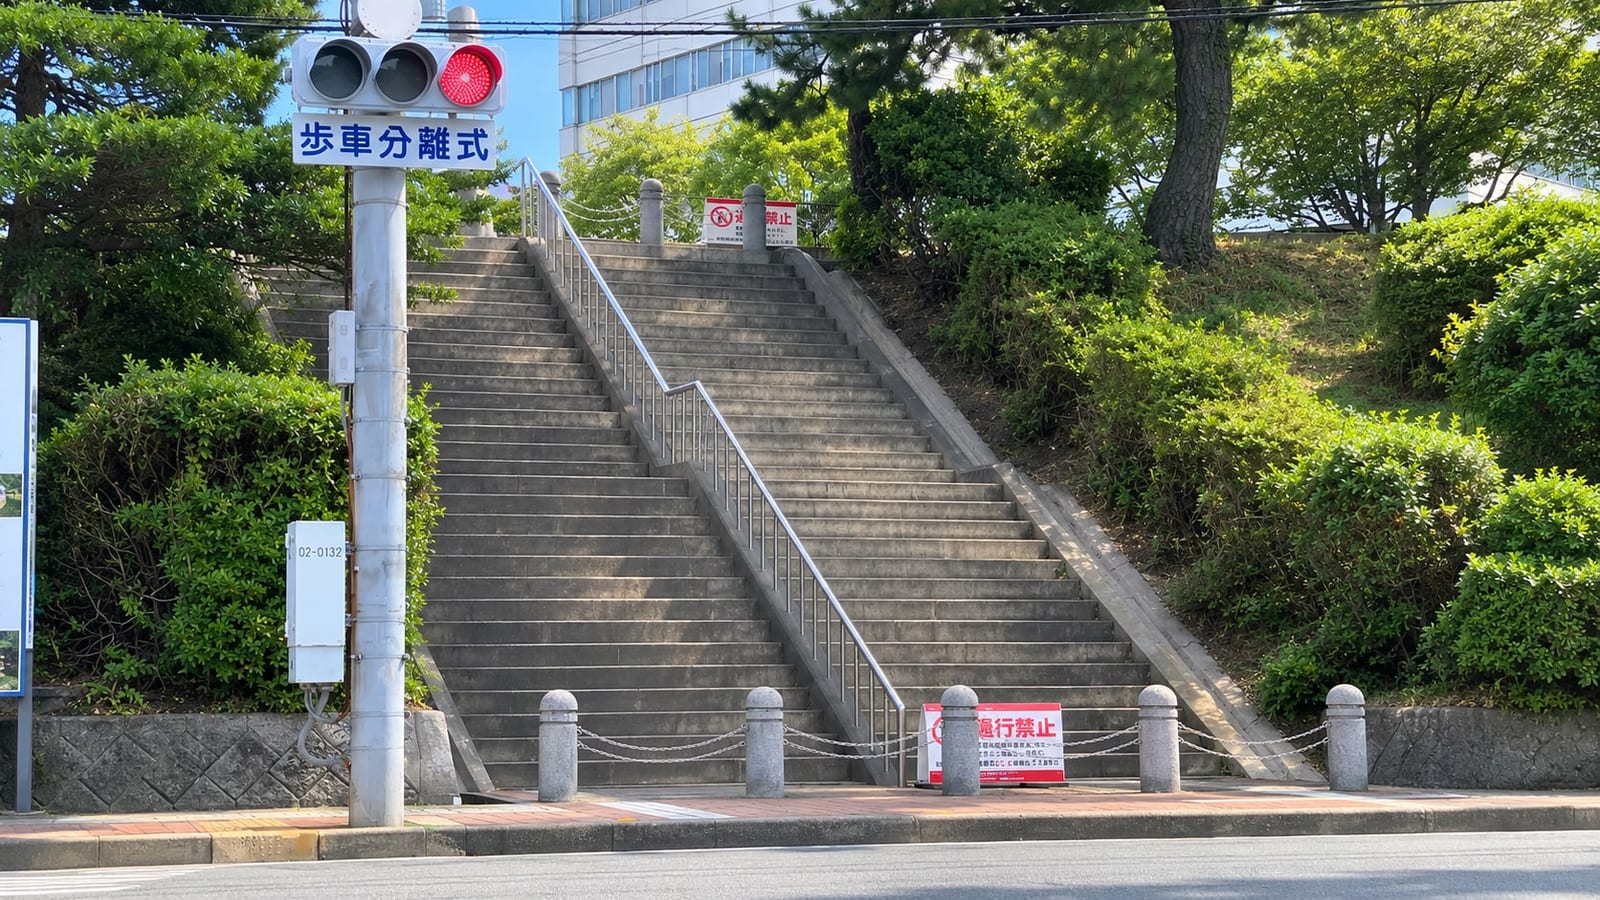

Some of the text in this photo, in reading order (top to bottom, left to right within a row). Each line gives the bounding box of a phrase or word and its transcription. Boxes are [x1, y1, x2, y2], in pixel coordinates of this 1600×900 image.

[300, 121, 489, 161] 歩車分離式
[299, 546, 343, 558] 02-0132
